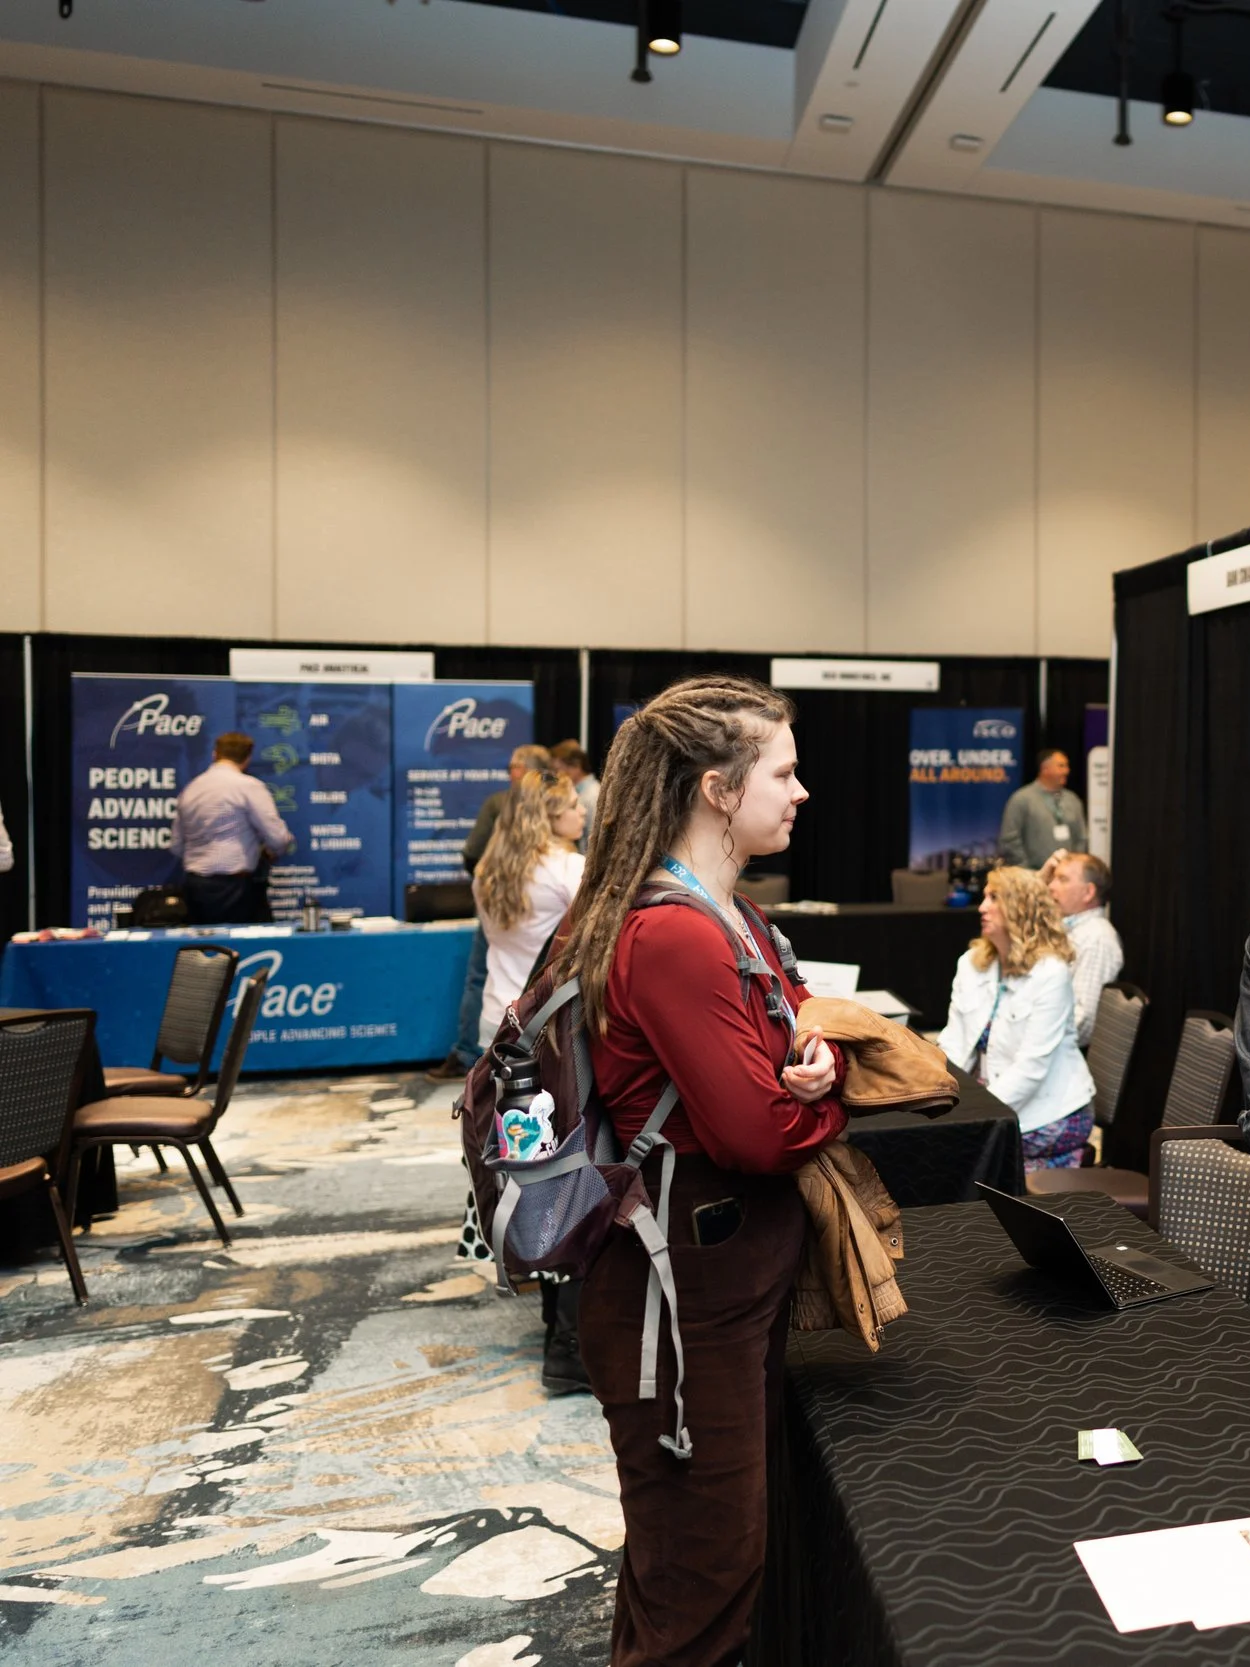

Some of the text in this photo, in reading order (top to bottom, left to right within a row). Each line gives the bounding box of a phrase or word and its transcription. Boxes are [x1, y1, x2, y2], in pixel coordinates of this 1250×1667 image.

[89, 767, 176, 790] PEOPLE
[88, 797, 178, 820] ADVANC
[88, 827, 172, 850] SCIENC
[88, 885, 145, 900] Providin
[249, 1028, 276, 1044] OPLE
[350, 1022, 397, 1038] SCIENCE
